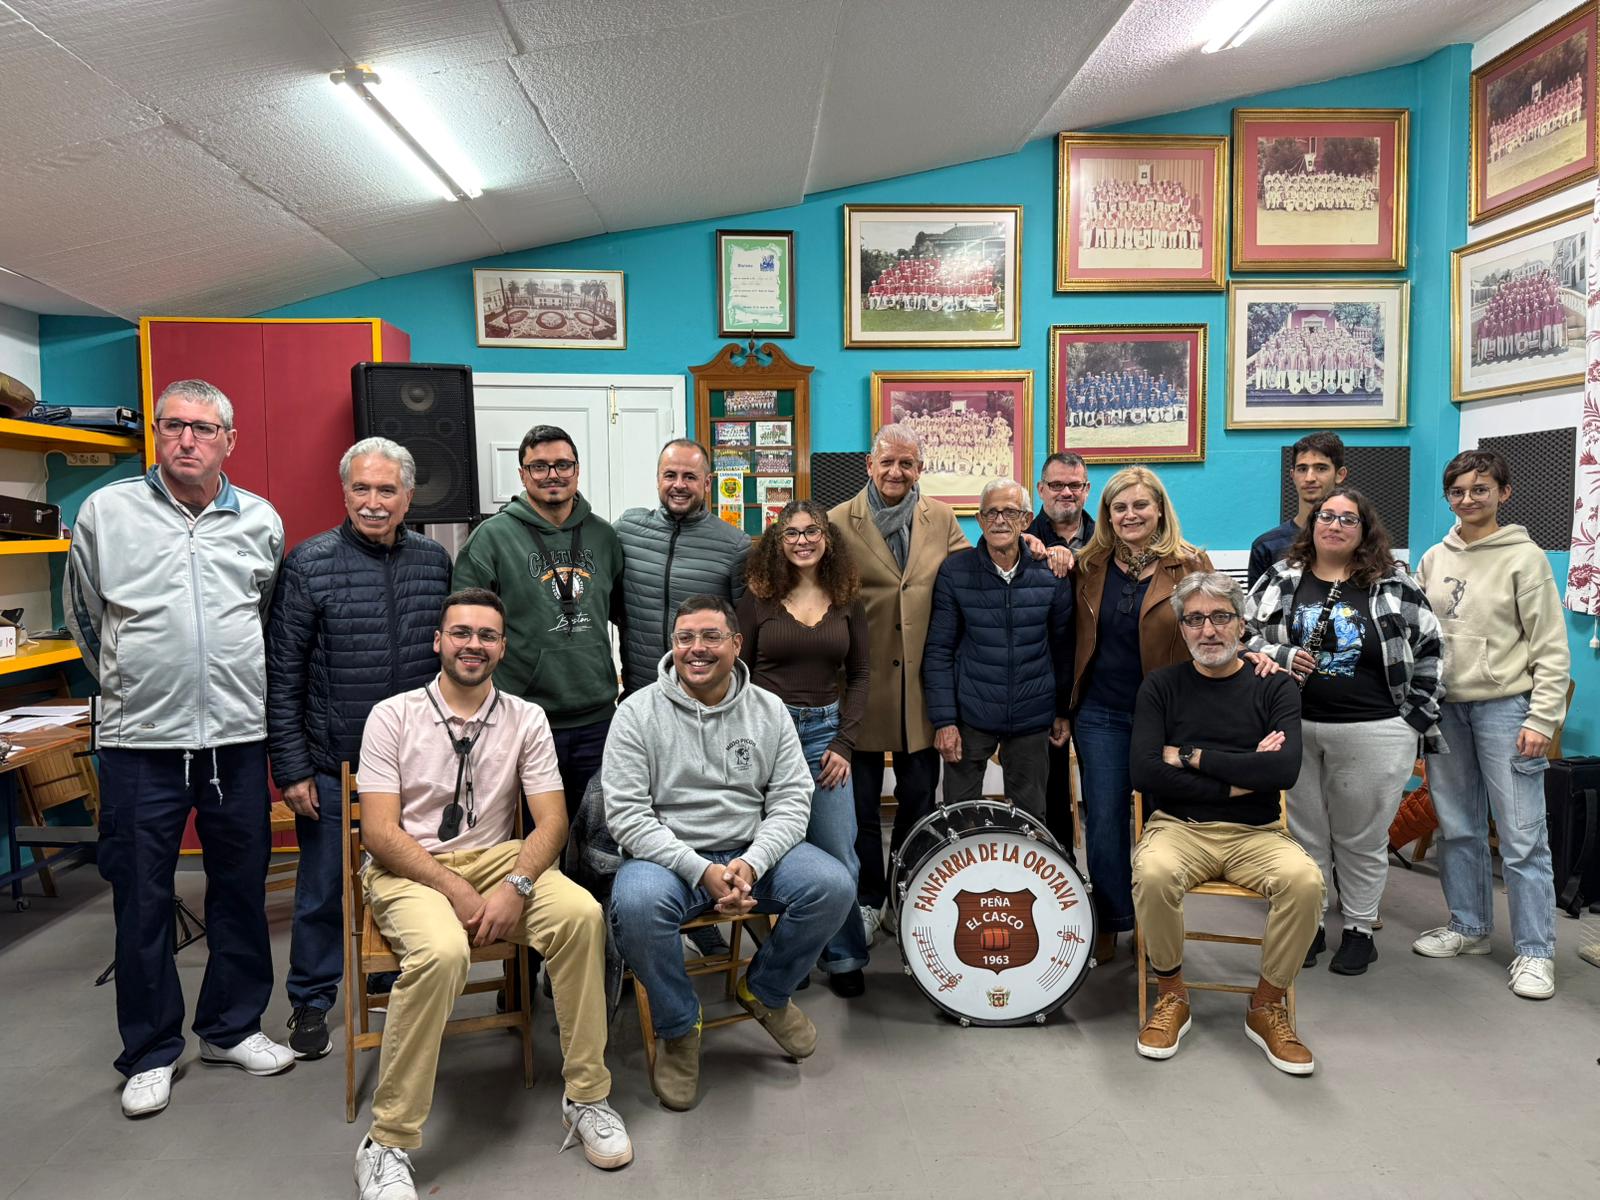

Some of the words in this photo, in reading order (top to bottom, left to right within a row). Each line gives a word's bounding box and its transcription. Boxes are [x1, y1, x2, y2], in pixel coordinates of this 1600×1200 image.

[548, 612, 592, 632] Bston
[914, 847, 978, 912] FANFARRIA
[978, 842, 998, 863] DE
[1002, 843, 1020, 864] LA
[1023, 850, 1079, 911] OROTAVA
[980, 896, 1011, 908] PEÑA
[966, 917, 982, 931] EL
[982, 911, 1024, 930] CASCO
[982, 955, 1010, 965] 1963
